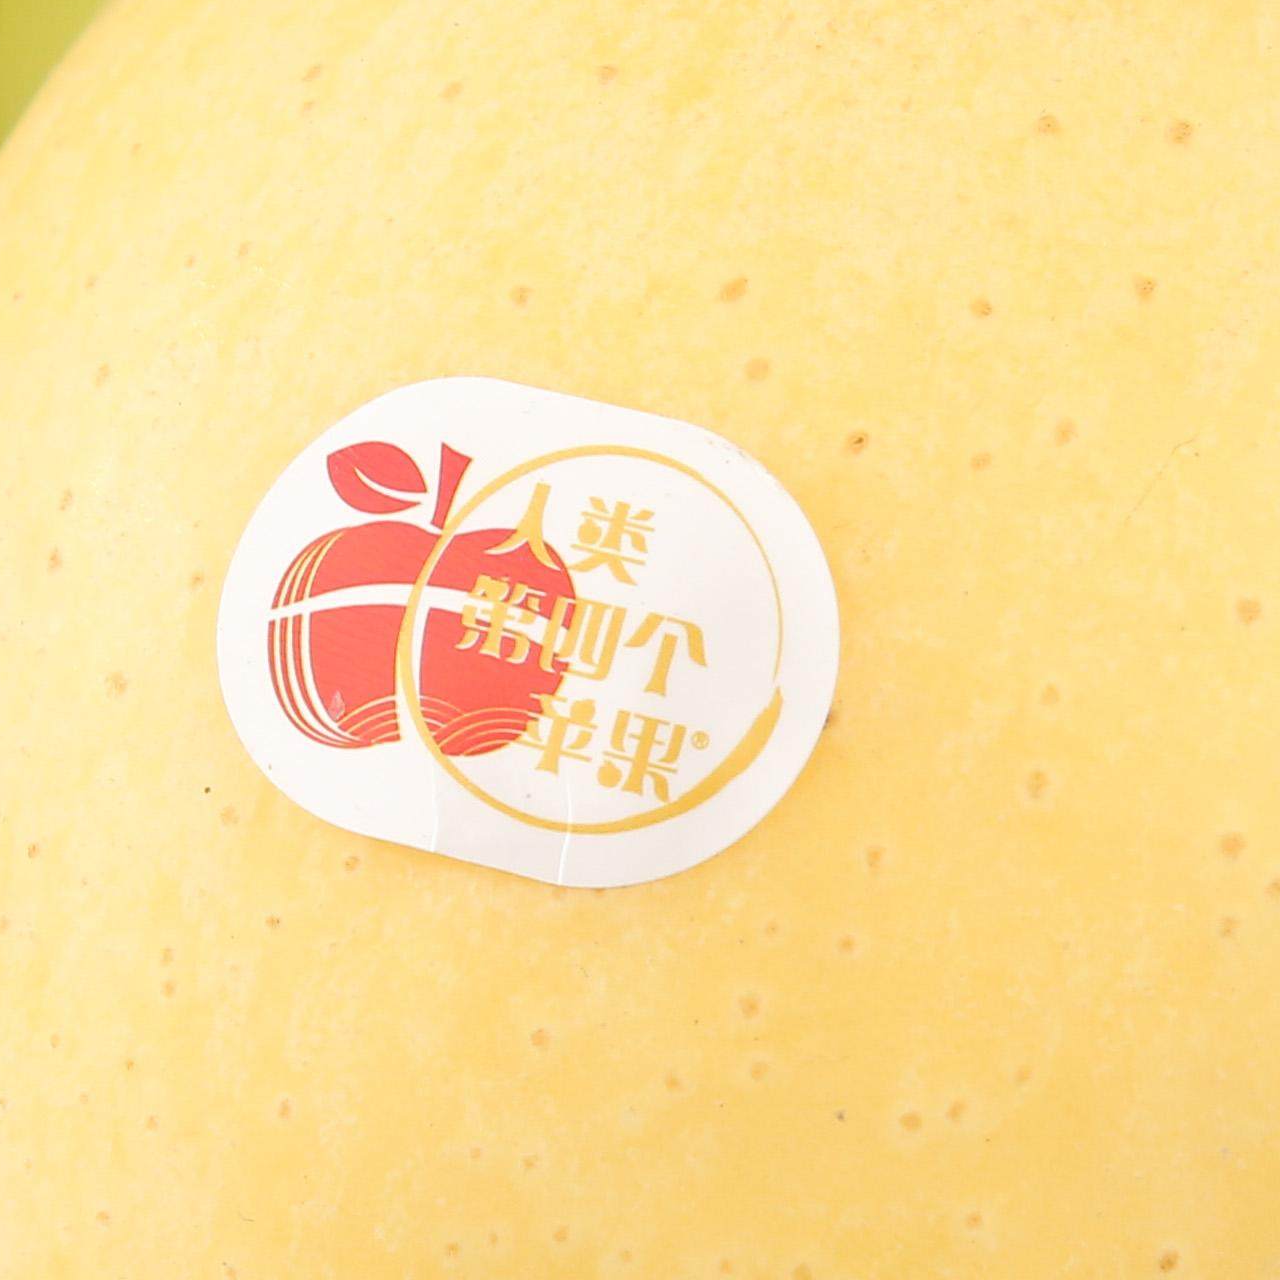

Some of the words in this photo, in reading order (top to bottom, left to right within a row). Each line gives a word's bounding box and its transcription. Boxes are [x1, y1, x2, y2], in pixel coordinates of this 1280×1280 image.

[484, 481, 655, 586] 人类
[455, 574, 707, 696] 第四个
